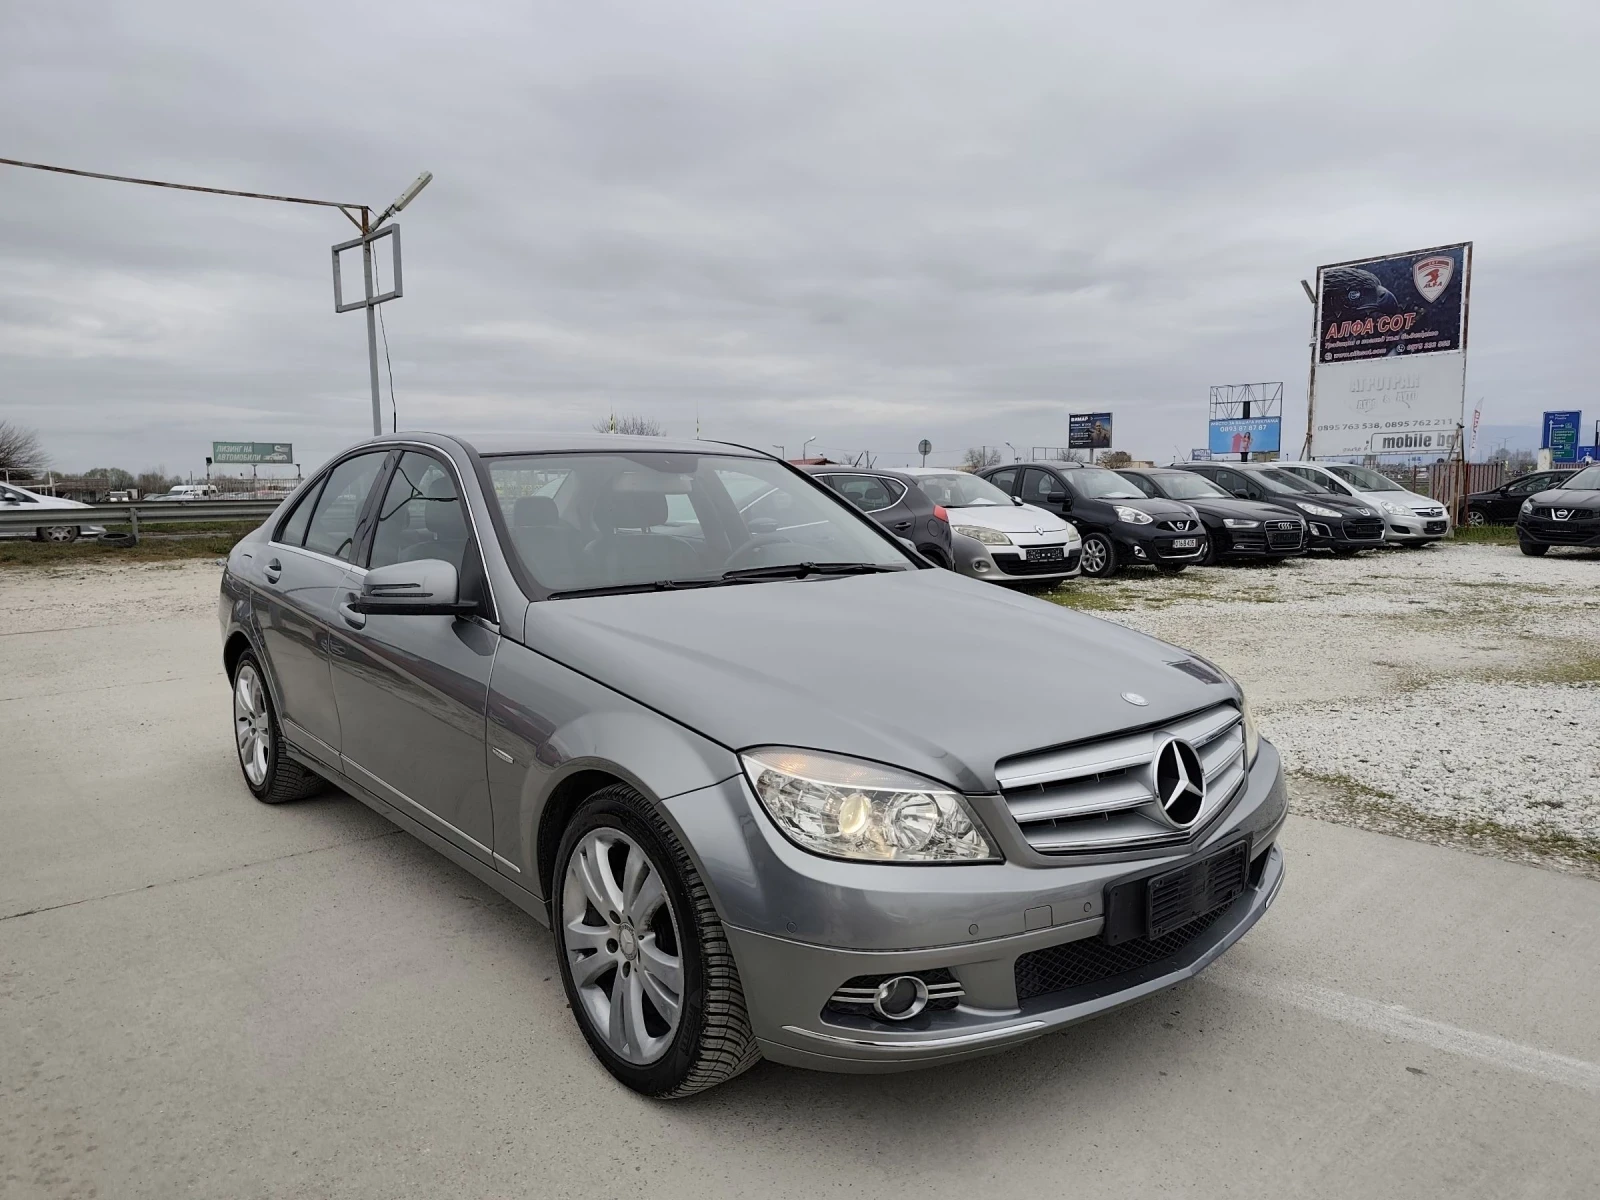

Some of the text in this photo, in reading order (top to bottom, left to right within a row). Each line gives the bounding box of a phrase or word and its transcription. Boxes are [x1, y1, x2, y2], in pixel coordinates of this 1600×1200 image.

[1326, 312, 1416, 340] АЛФА СОТ
[1317, 424, 1340, 432] 0895
[1342, 423, 1360, 431] 763
[1362, 422, 1383, 430] 538,
[1412, 419, 1432, 427] 762
[1434, 418, 1453, 426] 211
[216, 453, 261, 461] АВТОМОБИЛИ
